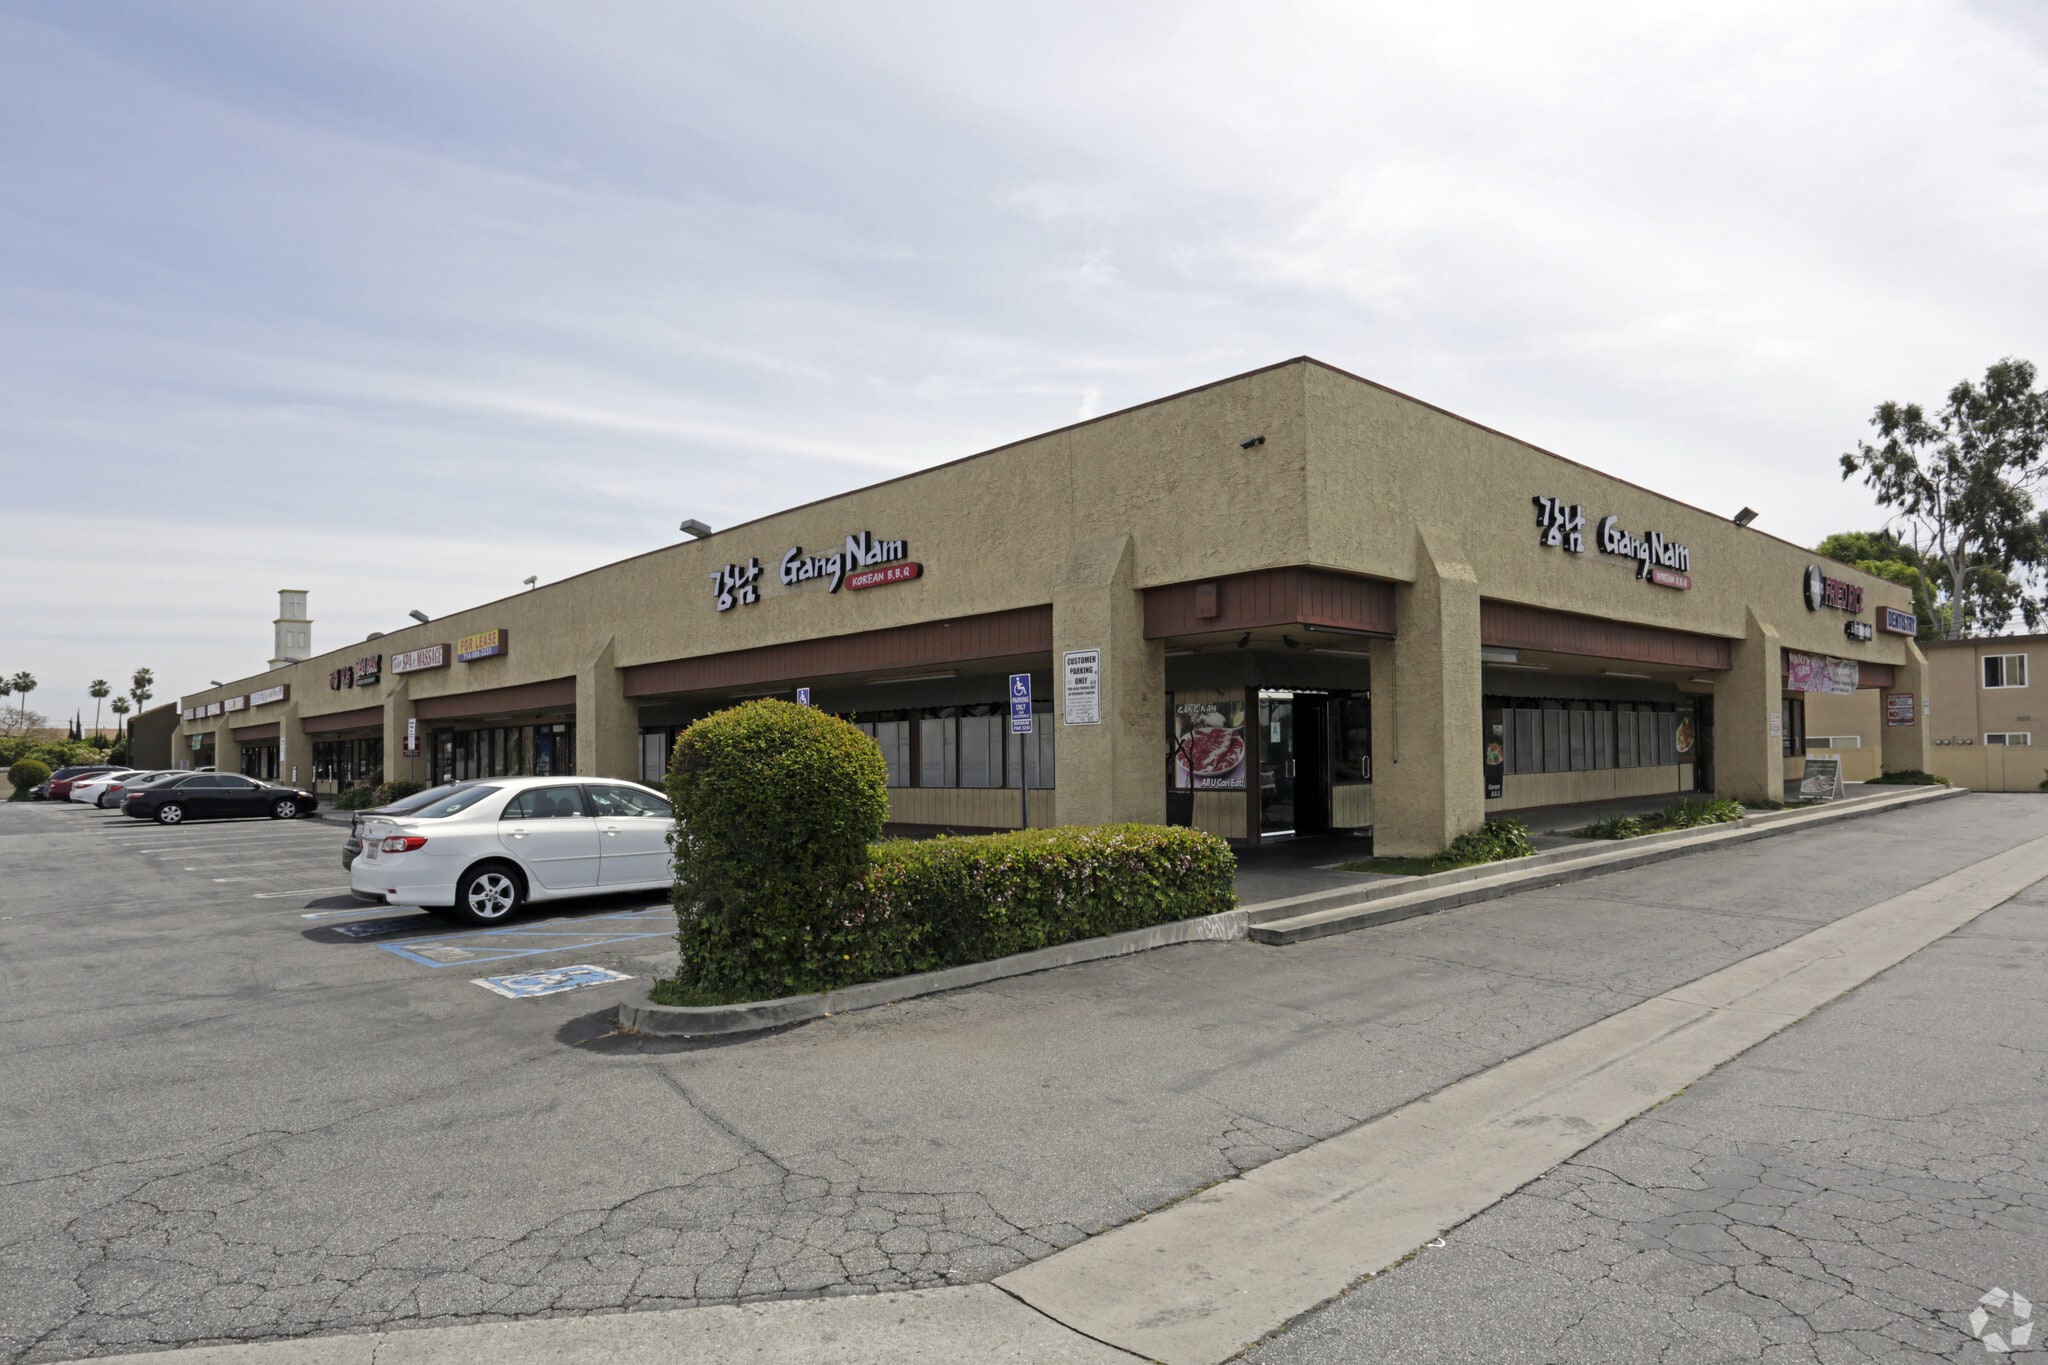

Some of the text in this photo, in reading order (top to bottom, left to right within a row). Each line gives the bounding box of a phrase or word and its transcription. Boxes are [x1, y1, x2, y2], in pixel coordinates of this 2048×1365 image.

[1535, 496, 1586, 553] 강남
[709, 557, 762, 612] 강남
[851, 572, 884, 587] KOREAN
[1888, 610, 1915, 633] DENTISTRY
[460, 631, 497, 652] FOR LEASE
[401, 653, 412, 670] SPA
[416, 646, 442, 667] MASSAGE
[1067, 655, 1096, 666] CUSTOMER
[1070, 666, 1093, 675] PARKING
[1074, 676, 1088, 685] ONLY
[1012, 696, 1029, 704] PARKING
[1201, 778, 1211, 787] All
[1217, 779, 1230, 788] Can
